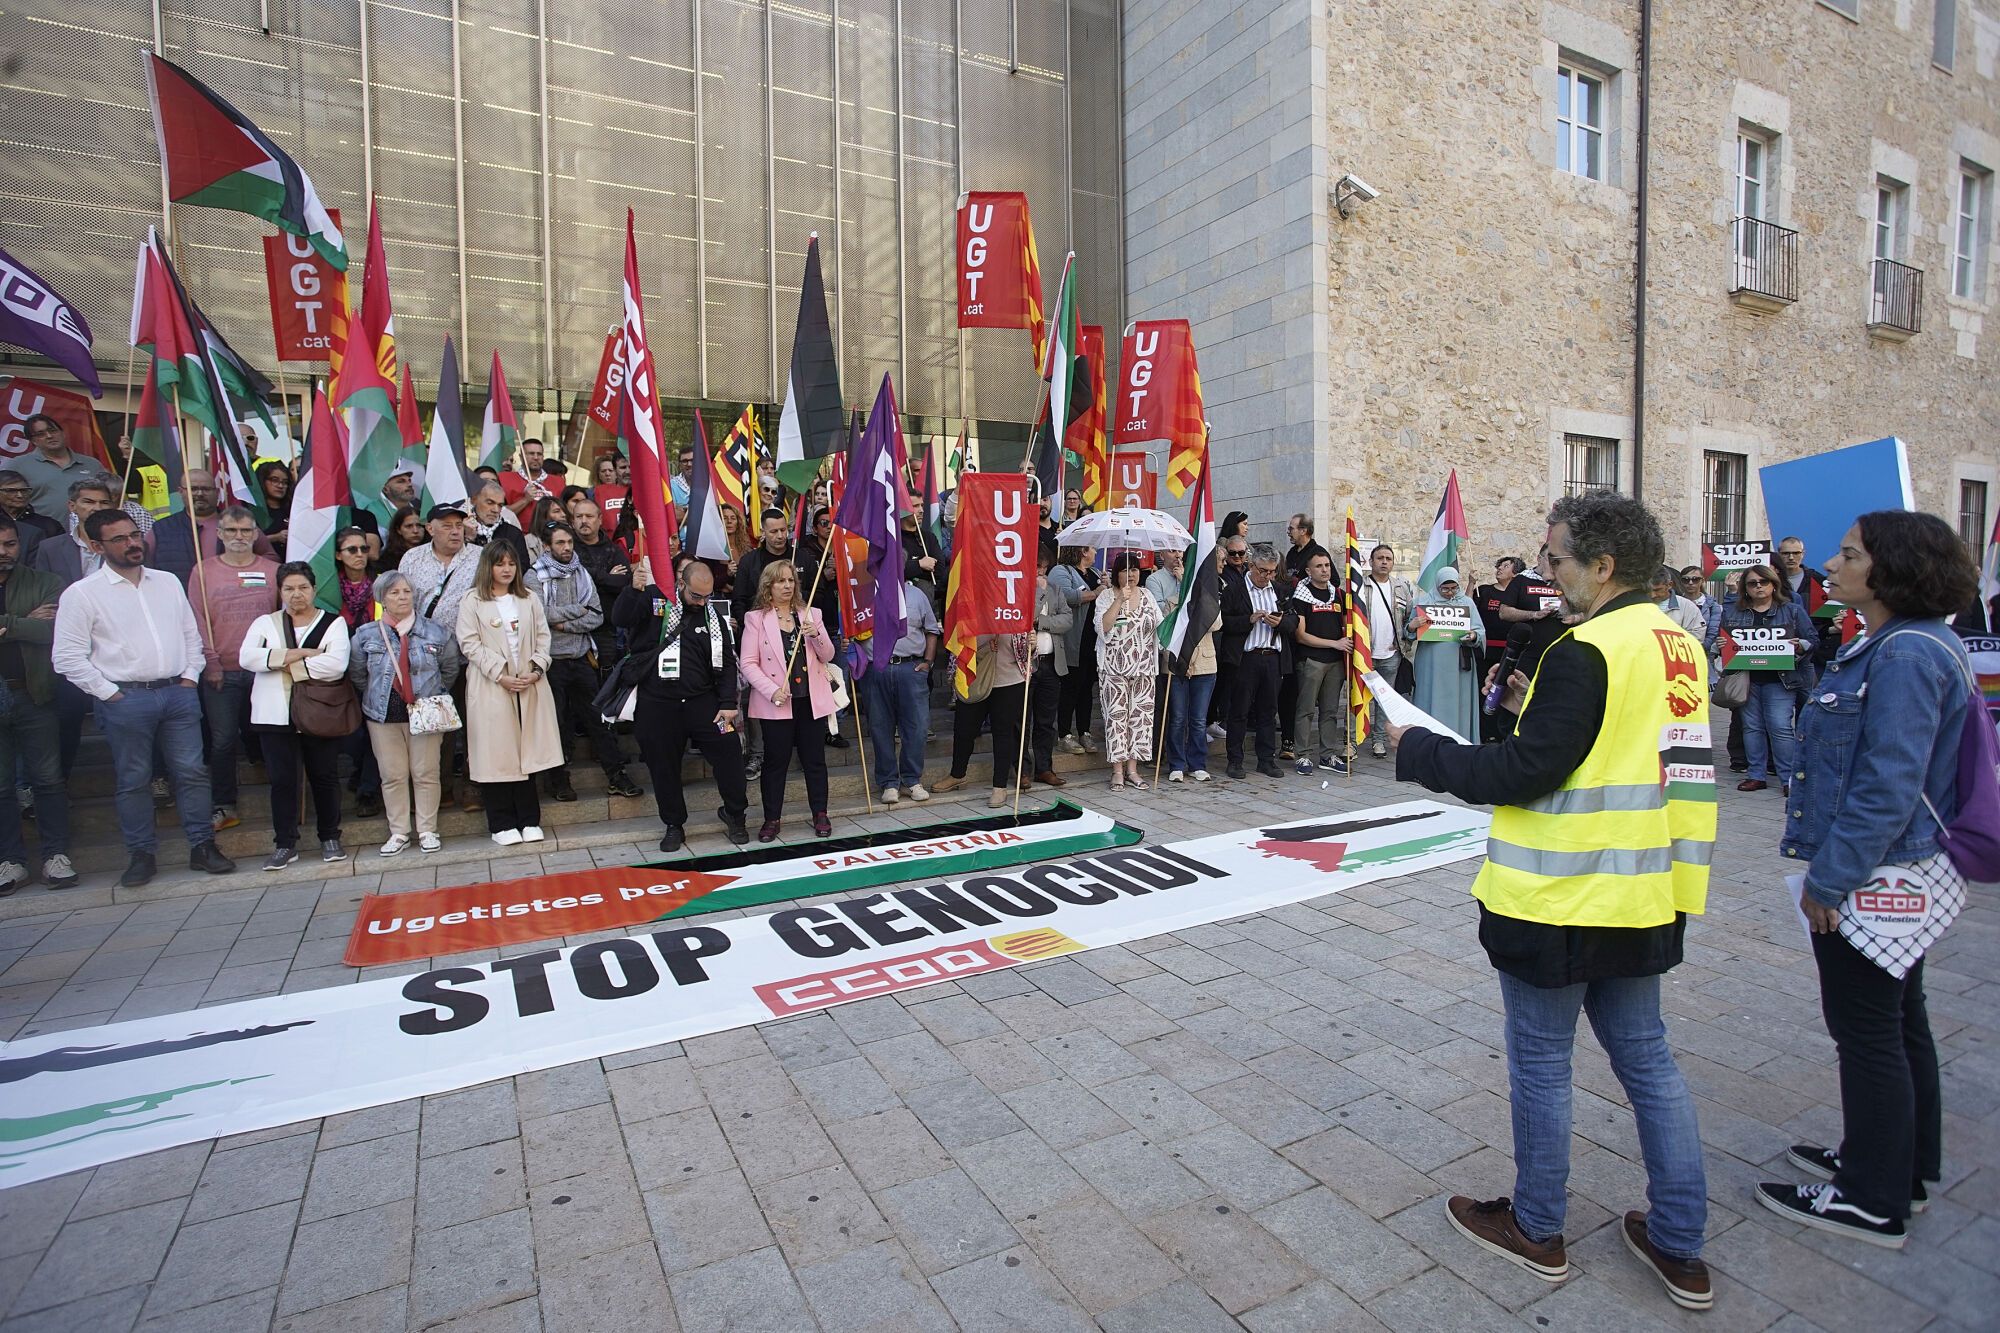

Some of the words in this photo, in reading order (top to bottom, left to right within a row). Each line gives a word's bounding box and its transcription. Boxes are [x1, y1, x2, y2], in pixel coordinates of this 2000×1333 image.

[966, 204, 994, 301] UGT
[287, 232, 323, 333] UGT
[963, 303, 984, 315] .cat
[296, 335, 331, 348] .cat
[1129, 331, 1159, 418] UGT
[0, 388, 46, 454] UG
[1123, 418, 1147, 432] .cat
[1713, 543, 1764, 556] STOP
[1713, 558, 1762, 566] GENOCIDIO
[1425, 606, 1465, 618] STOP
[1731, 627, 1786, 641] STOP
[1732, 644, 1786, 652] GENOCIDIO
[1964, 639, 2000, 653] HO
[368, 893, 604, 935] Ugetistes
[619, 878, 692, 901] per
[813, 831, 1025, 871] PALESTINA
[1860, 895, 1922, 909] CCOO
[1875, 914, 1921, 923] Palestina
[399, 926, 732, 1035] STOP
[768, 845, 1230, 958] GENOCIDI
[776, 950, 990, 1006] CCOO
